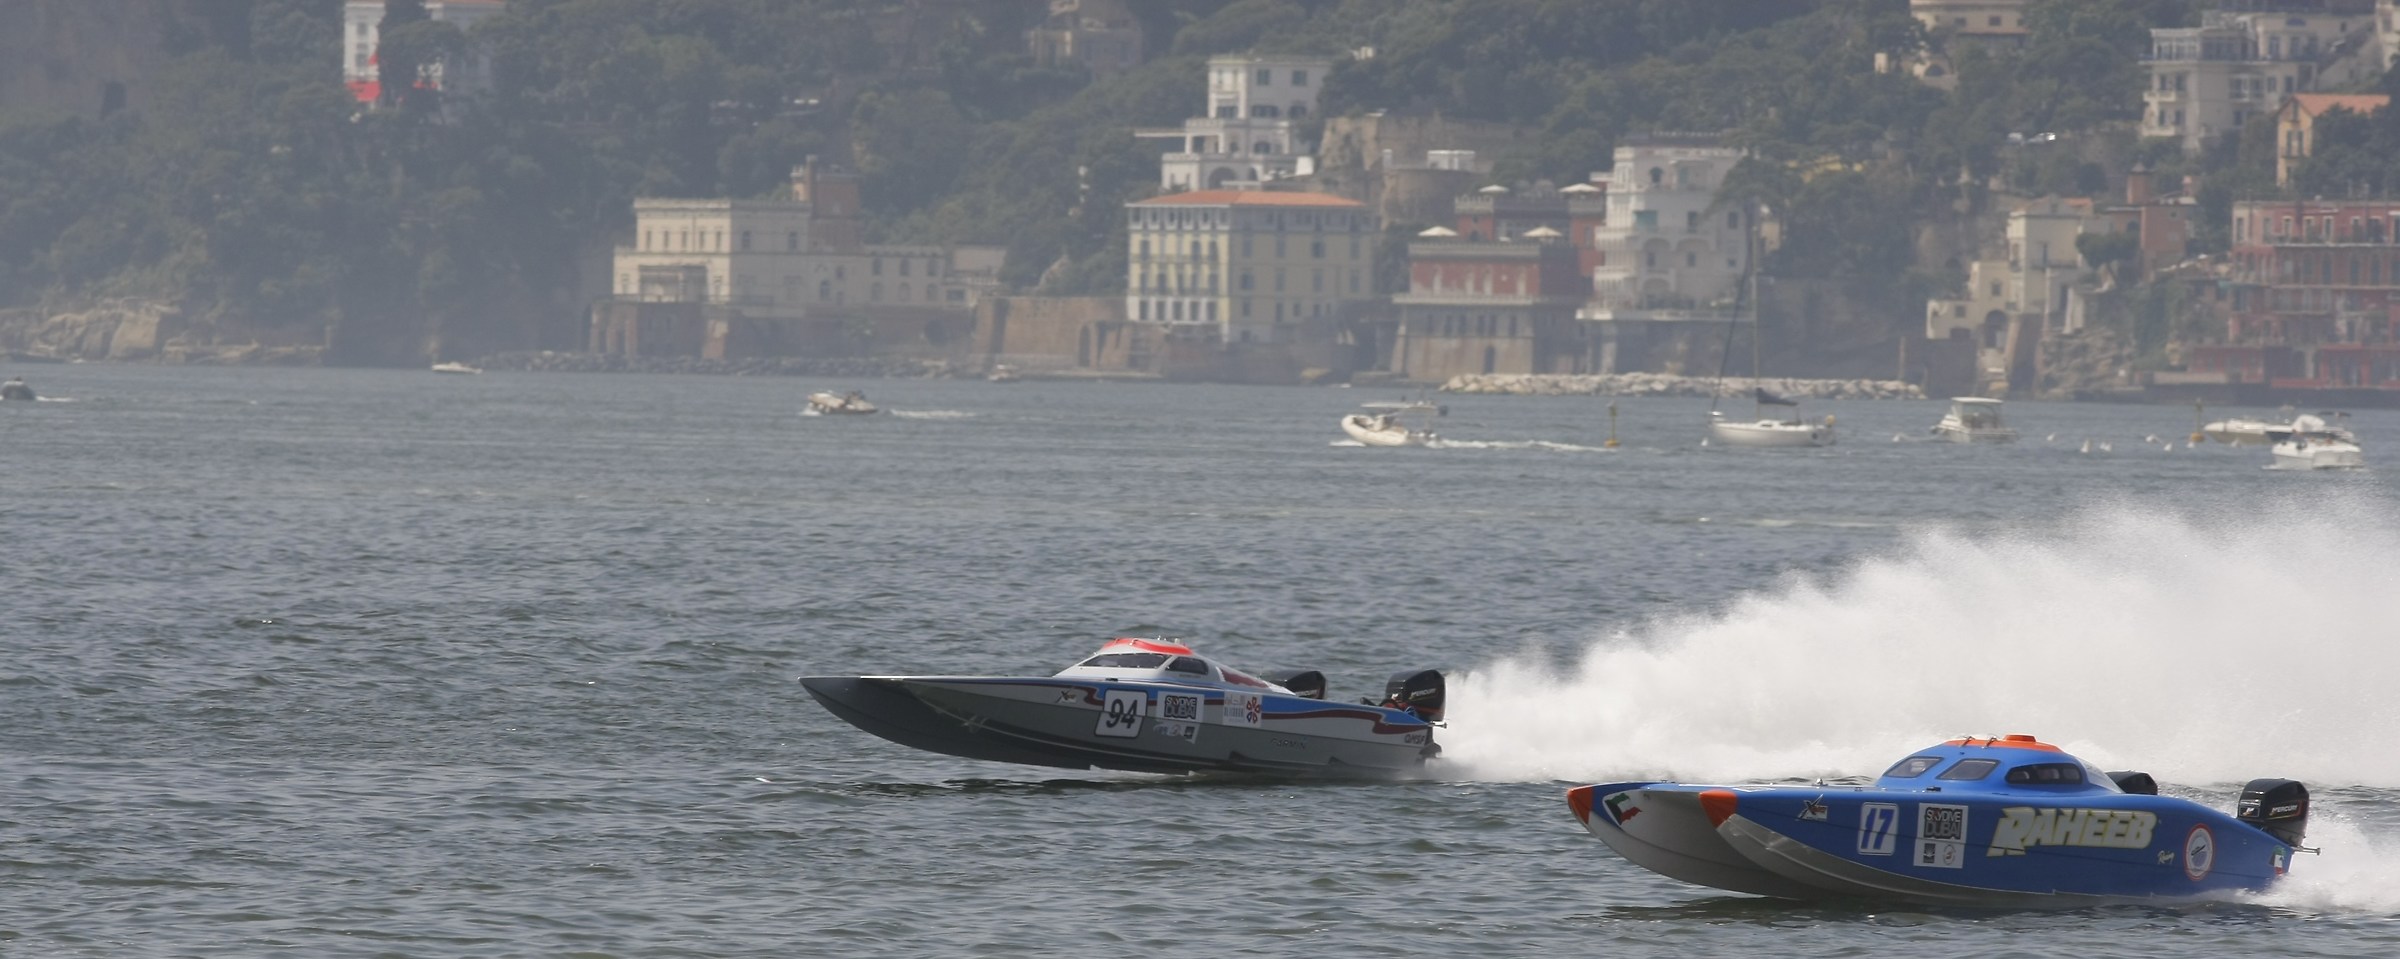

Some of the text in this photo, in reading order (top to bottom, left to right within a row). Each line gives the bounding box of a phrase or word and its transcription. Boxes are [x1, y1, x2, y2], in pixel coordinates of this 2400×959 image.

[1166, 696, 1196, 706] SKYDIVE
[1106, 698, 1138, 729] 94
[1165, 705, 1196, 718] DUBAI
[1926, 809, 1961, 823] SKYDIVE
[1861, 808, 1894, 850] 17
[1925, 821, 1961, 838] DUBAI
[1986, 806, 2157, 857] RAHEEB
